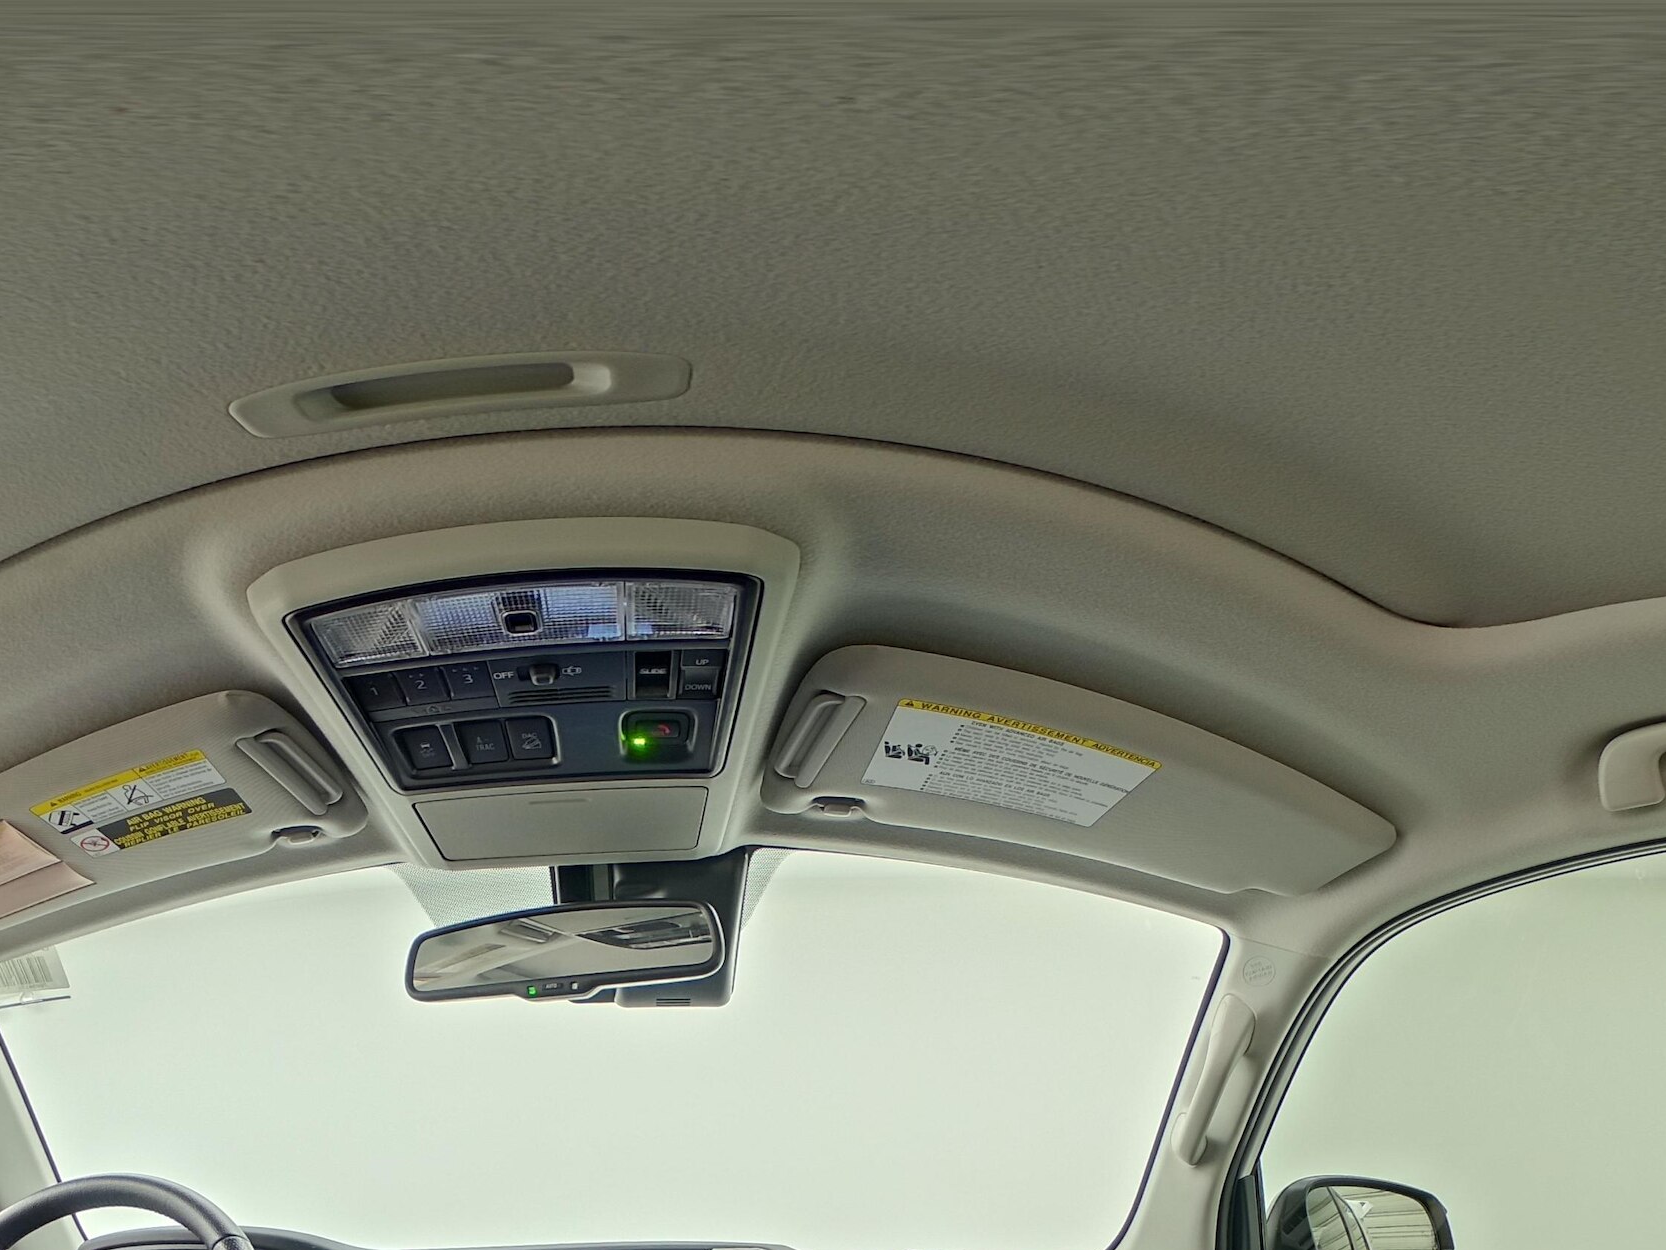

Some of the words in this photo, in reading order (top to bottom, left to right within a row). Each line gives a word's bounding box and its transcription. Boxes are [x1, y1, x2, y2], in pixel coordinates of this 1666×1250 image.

[464, 674, 474, 684] 3
[493, 671, 514, 680] OFF
[415, 680, 427, 690] 2
[370, 687, 378, 696] 1
[921, 703, 981, 719] WARNING
[987, 716, 1086, 745] AVERTISSEMENT
[1092, 743, 1156, 767] ADVERTENCIA
[475, 743, 494, 751] TRAC
[126, 816, 143, 826] AIR
[142, 810, 162, 822] BAG
[162, 797, 206, 813] WARNING
[187, 802, 245, 822] AVERTISSEMENT
[130, 821, 149, 832] FLIP
[154, 812, 183, 824] VISOR
[188, 803, 215, 814] OVER
